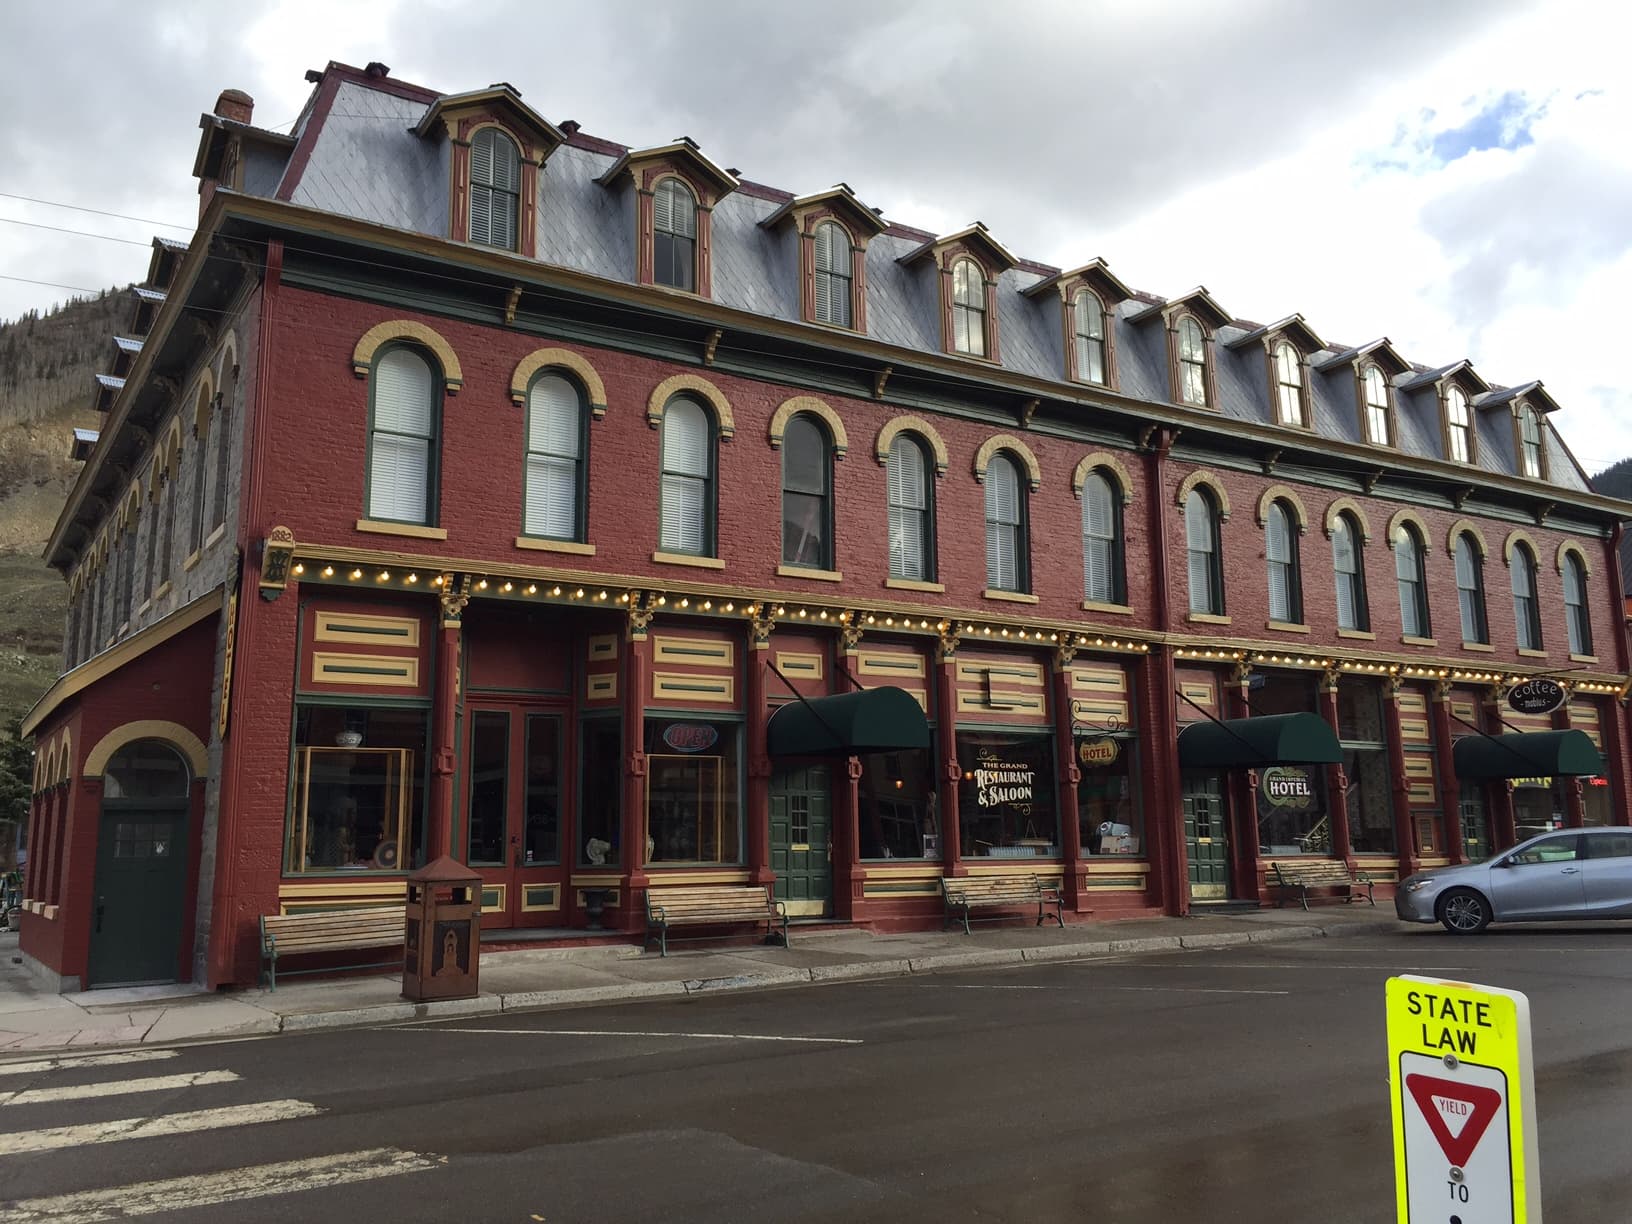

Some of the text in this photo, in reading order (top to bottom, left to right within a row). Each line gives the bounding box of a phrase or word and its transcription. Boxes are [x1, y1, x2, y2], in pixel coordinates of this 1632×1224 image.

[272, 529, 292, 542] 1882
[221, 603, 234, 725] HOTEL
[1515, 681, 1557, 698] coffee
[671, 727, 712, 746] OPEN
[1083, 747, 1112, 761] HOTEL
[974, 769, 1036, 791] RESTAURANT
[1270, 782, 1311, 796] HOTEL
[978, 786, 1033, 808] & SALOON
[1407, 992, 1492, 1027] STATE
[1422, 1023, 1477, 1055] LAW
[1439, 1099, 1467, 1116] YIELD
[1447, 1181, 1469, 1203] TO
